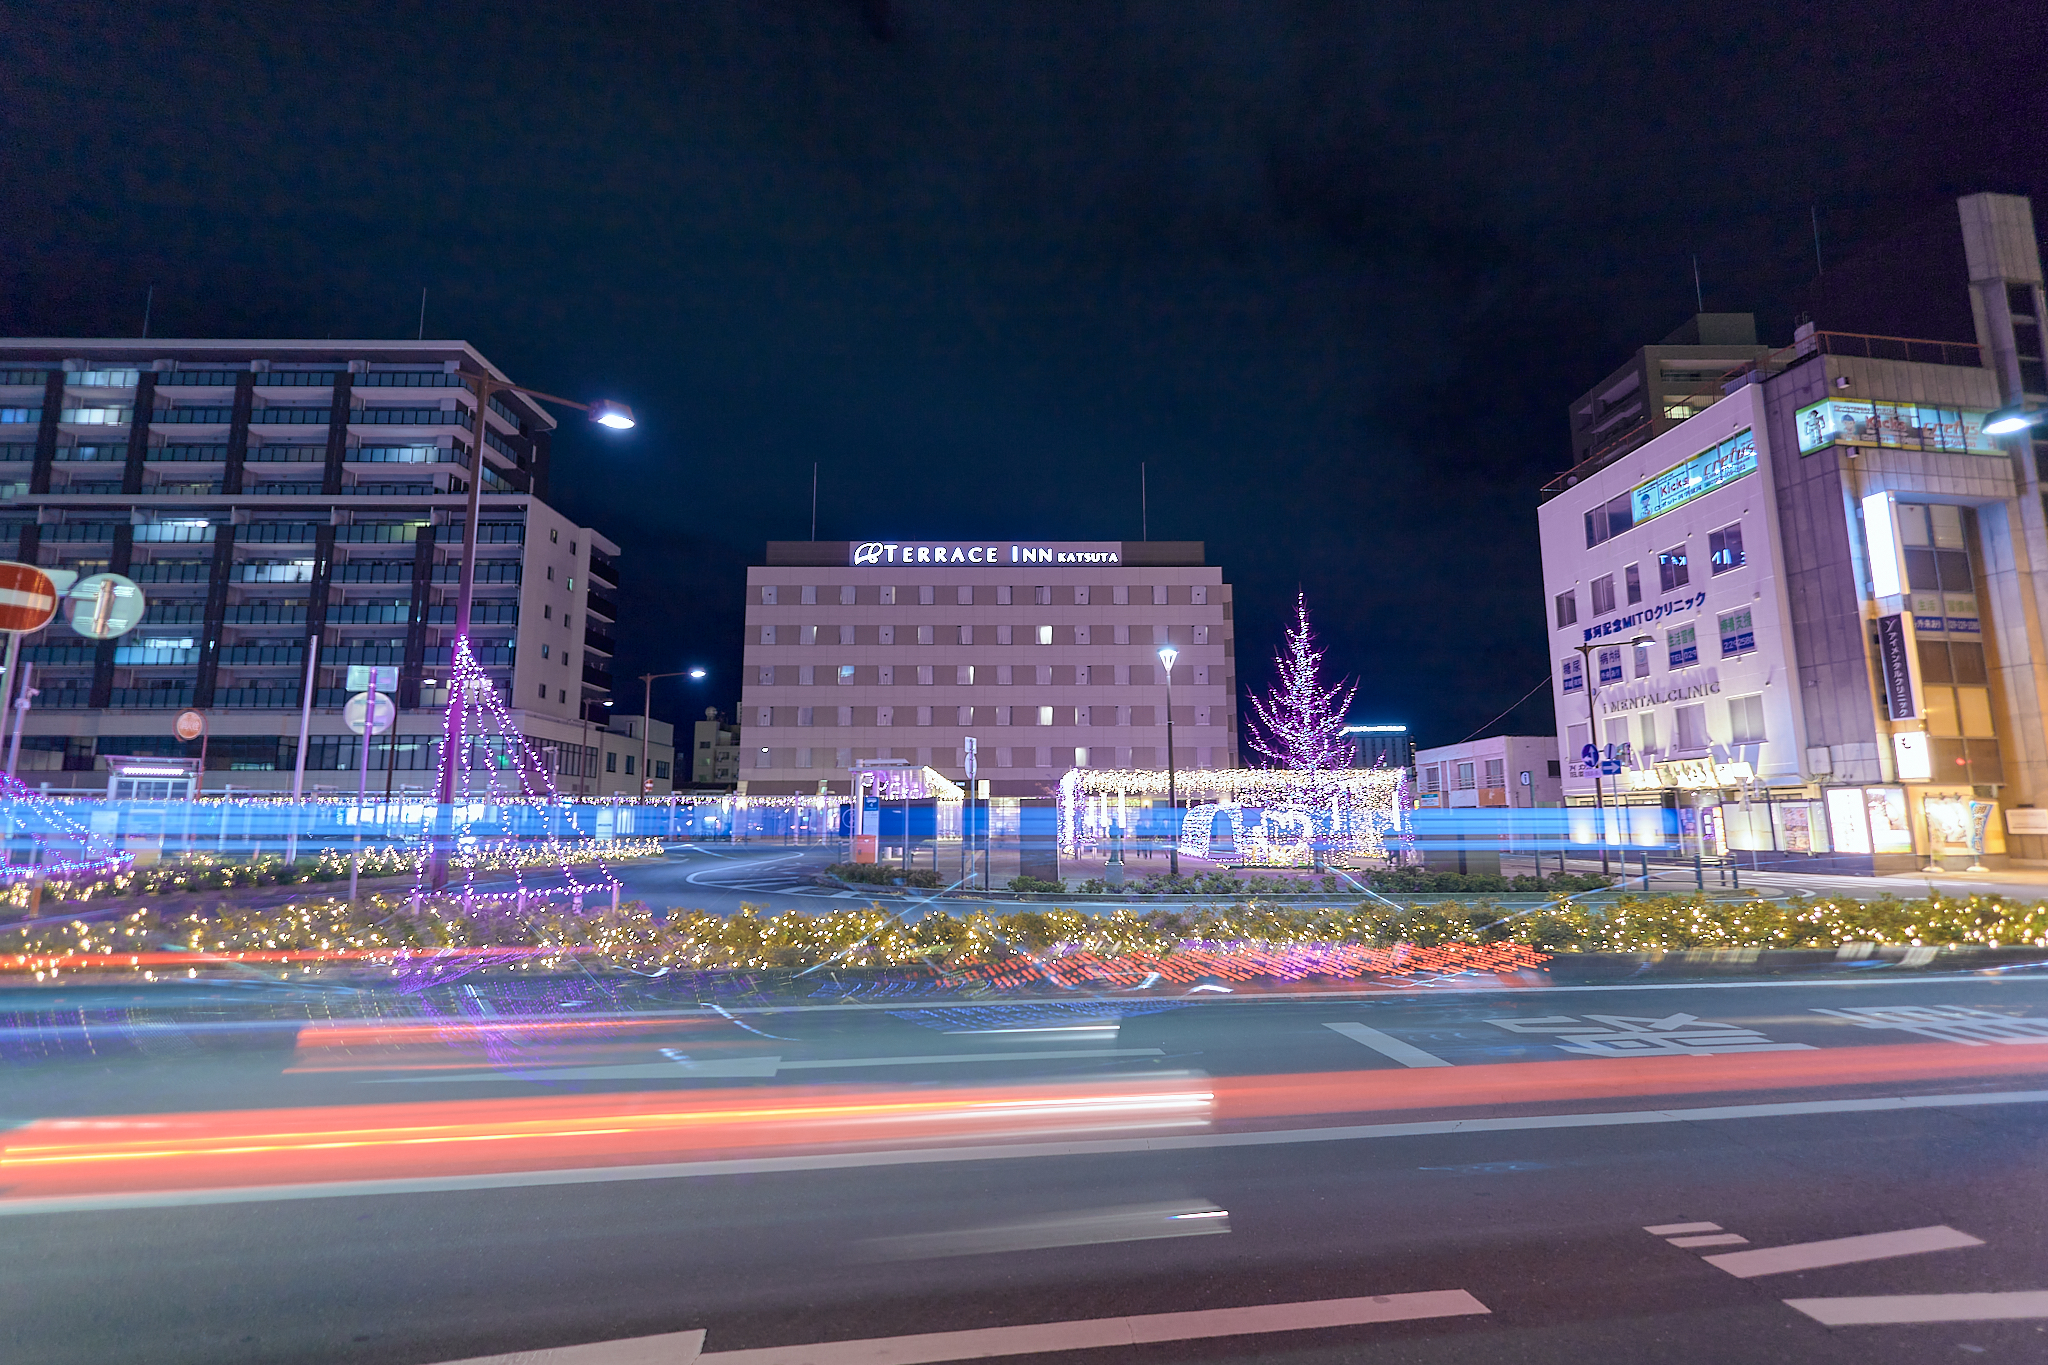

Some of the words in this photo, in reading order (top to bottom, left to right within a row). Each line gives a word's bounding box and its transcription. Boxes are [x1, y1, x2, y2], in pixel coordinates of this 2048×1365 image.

[1660, 476, 1690, 498] Kicks
[883, 544, 998, 564] TERRACE
[1011, 545, 1053, 564] INN
[1056, 552, 1119, 564] KATSUTA
[1670, 653, 1683, 663] TEL
[1887, 631, 1909, 718] アイメンタルクリニック
[1610, 692, 1666, 714] MENTAL
[1667, 682, 1721, 701] CLINIC
